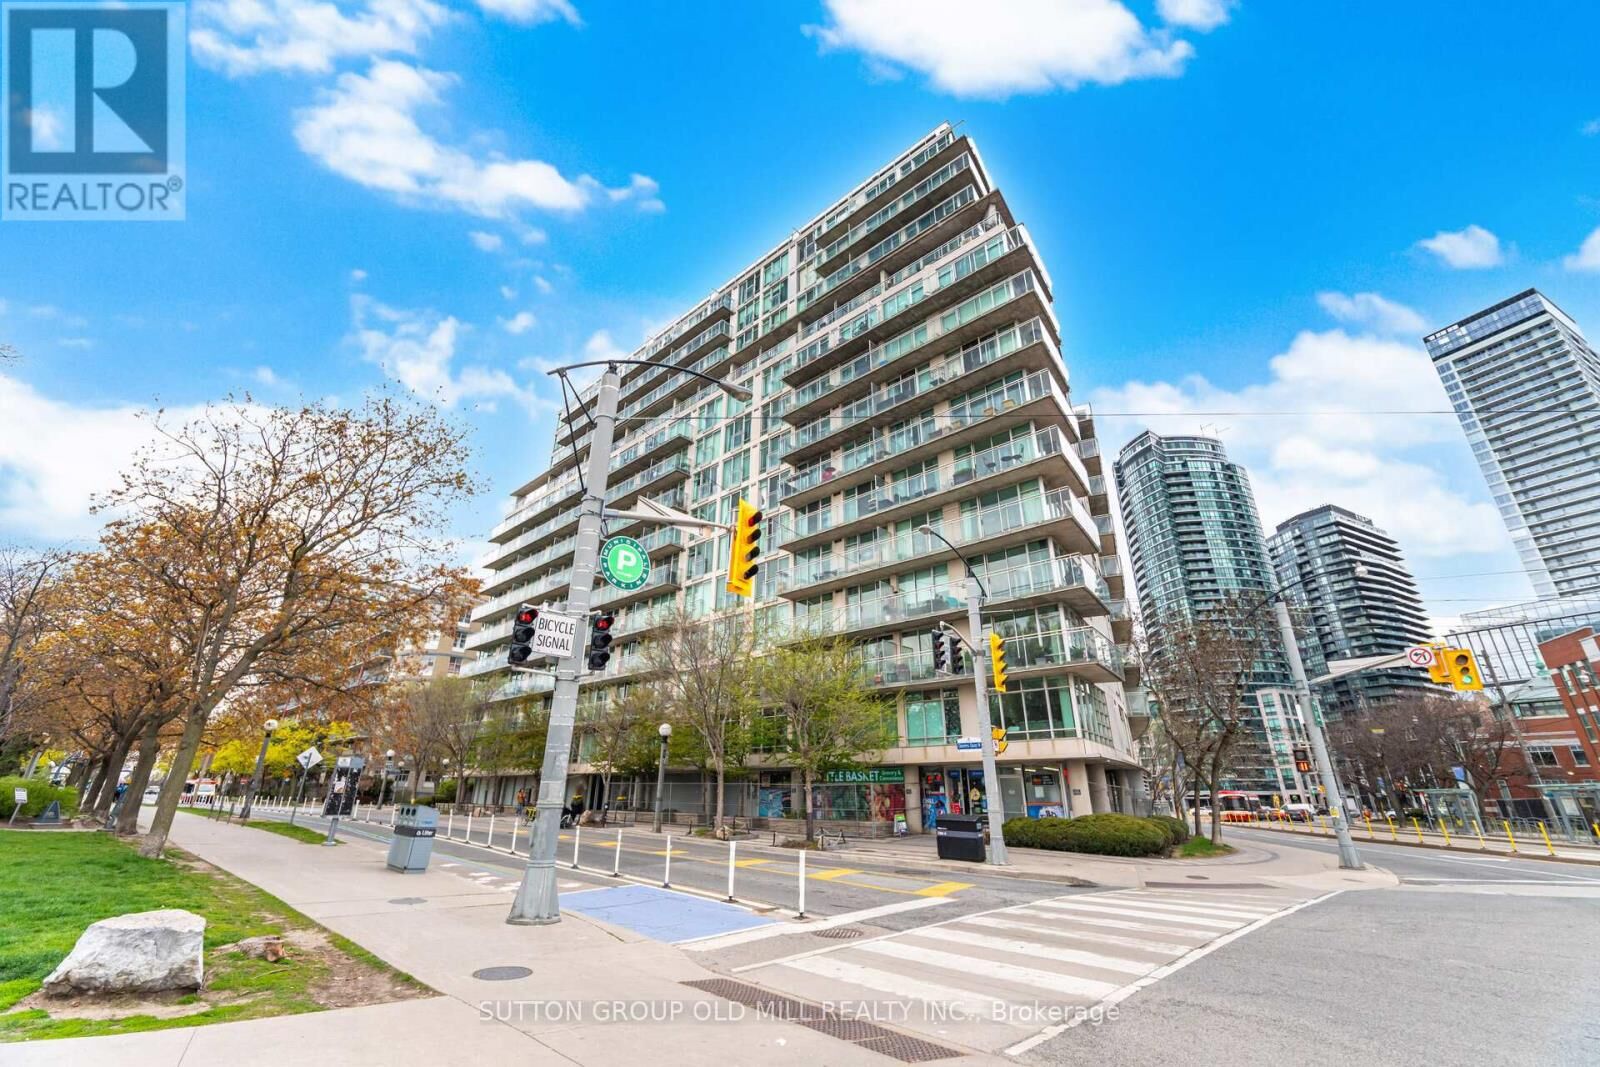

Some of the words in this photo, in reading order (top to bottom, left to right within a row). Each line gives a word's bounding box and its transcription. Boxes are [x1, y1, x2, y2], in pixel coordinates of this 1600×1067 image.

[617, 549, 637, 571] P
[602, 562, 647, 589] PARKING
[538, 617, 575, 635] BICYCLE
[536, 633, 570, 651] SIGNAL
[845, 770, 880, 782] BASKET
